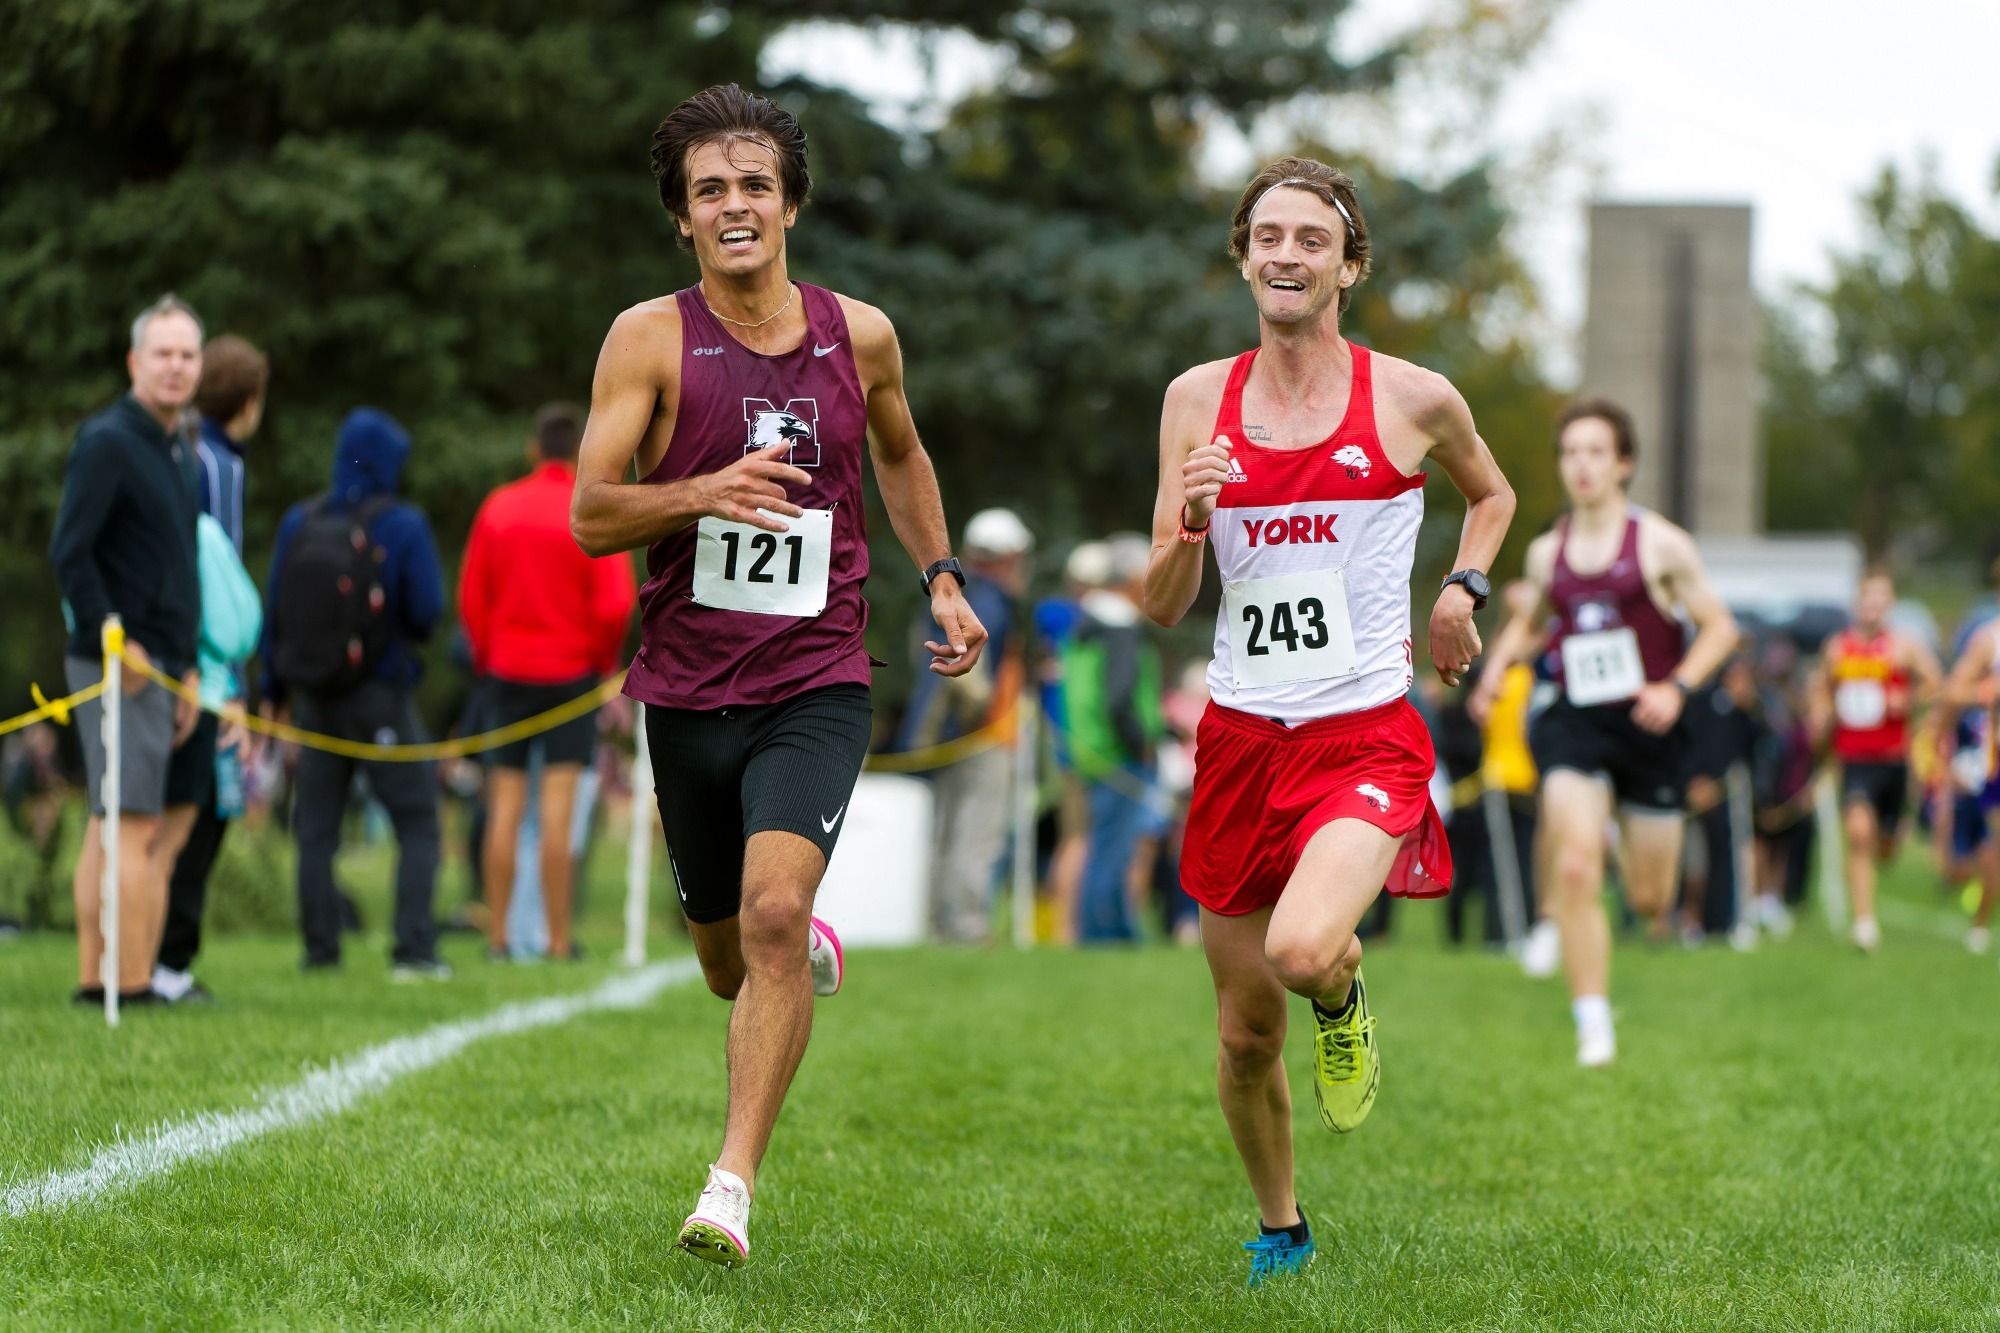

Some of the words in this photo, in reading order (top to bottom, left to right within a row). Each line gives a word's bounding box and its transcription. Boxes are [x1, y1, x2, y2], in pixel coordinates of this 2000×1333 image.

[1227, 473, 1248, 483] das
[1242, 514, 1339, 547] YORK
[720, 531, 803, 584] 121
[1242, 597, 1329, 656] 243
